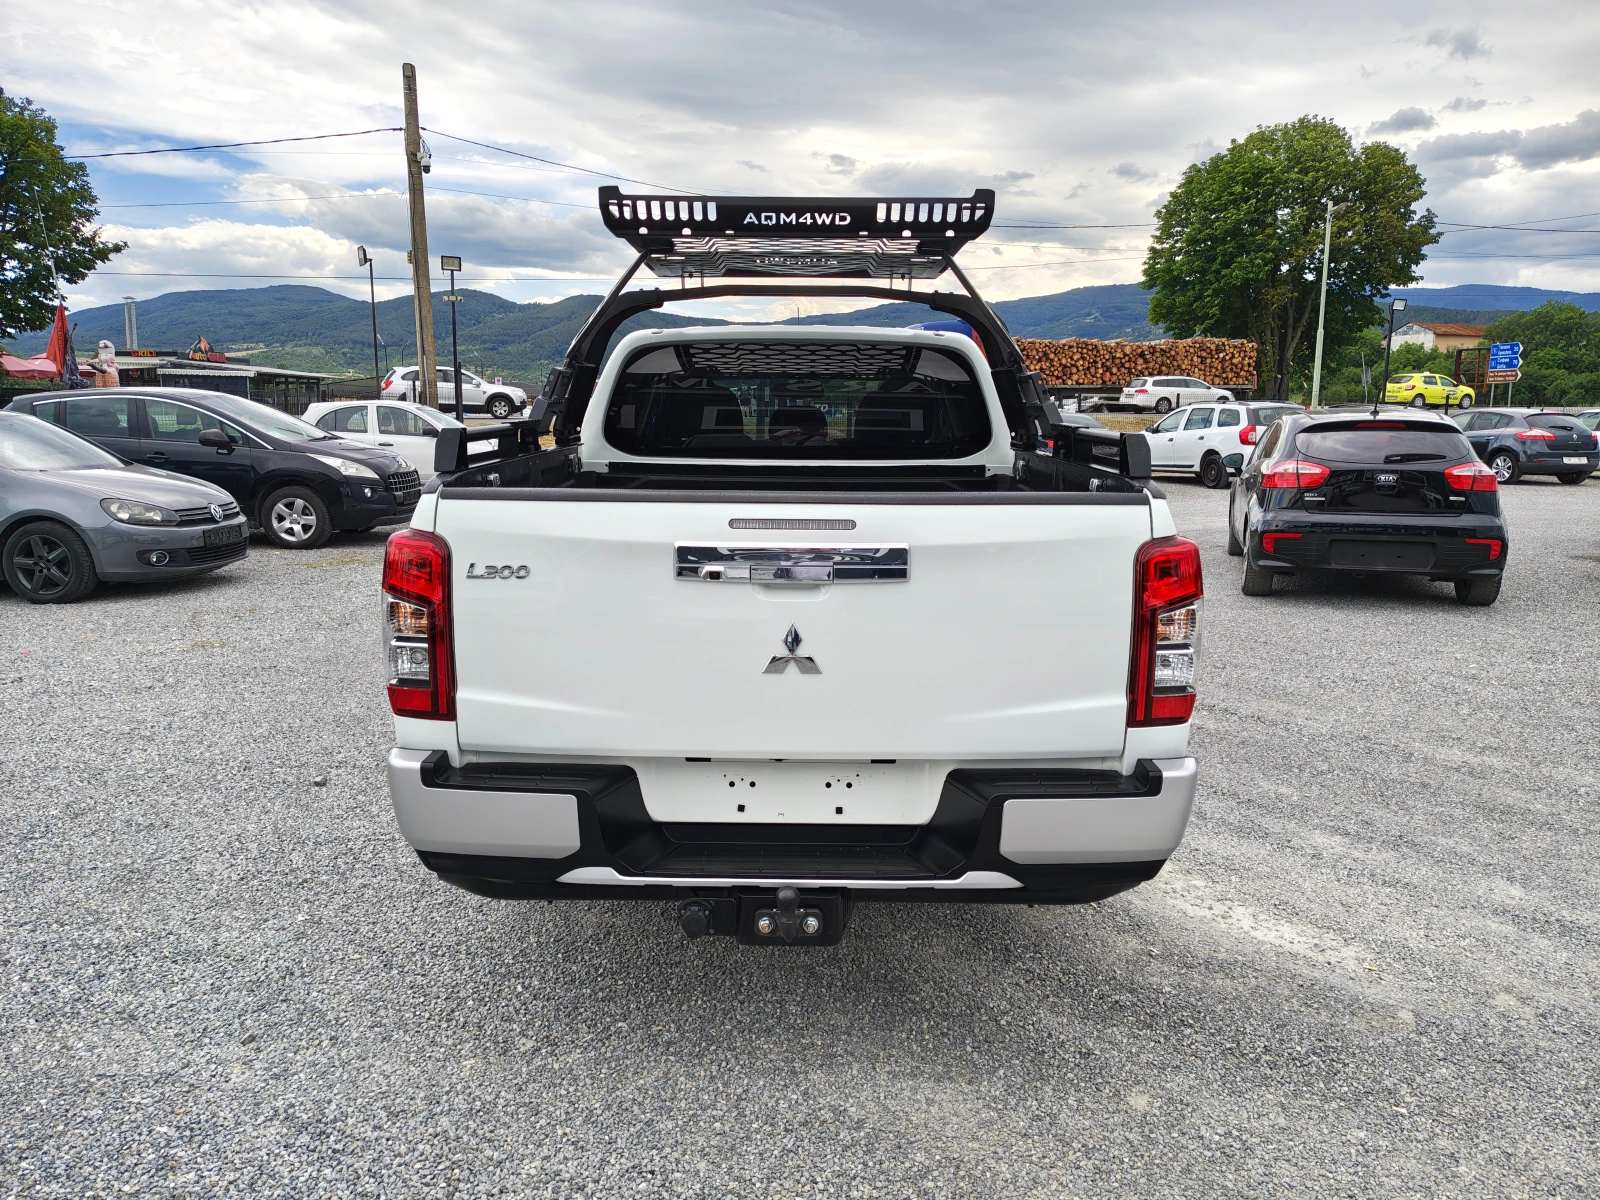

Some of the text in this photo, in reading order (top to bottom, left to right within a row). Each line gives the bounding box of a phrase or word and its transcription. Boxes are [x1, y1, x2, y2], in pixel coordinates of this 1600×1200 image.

[743, 212, 851, 226] AQM4WD
[207, 351, 228, 363] GRILL
[1378, 475, 1397, 483] KIA
[465, 562, 531, 580] L200
